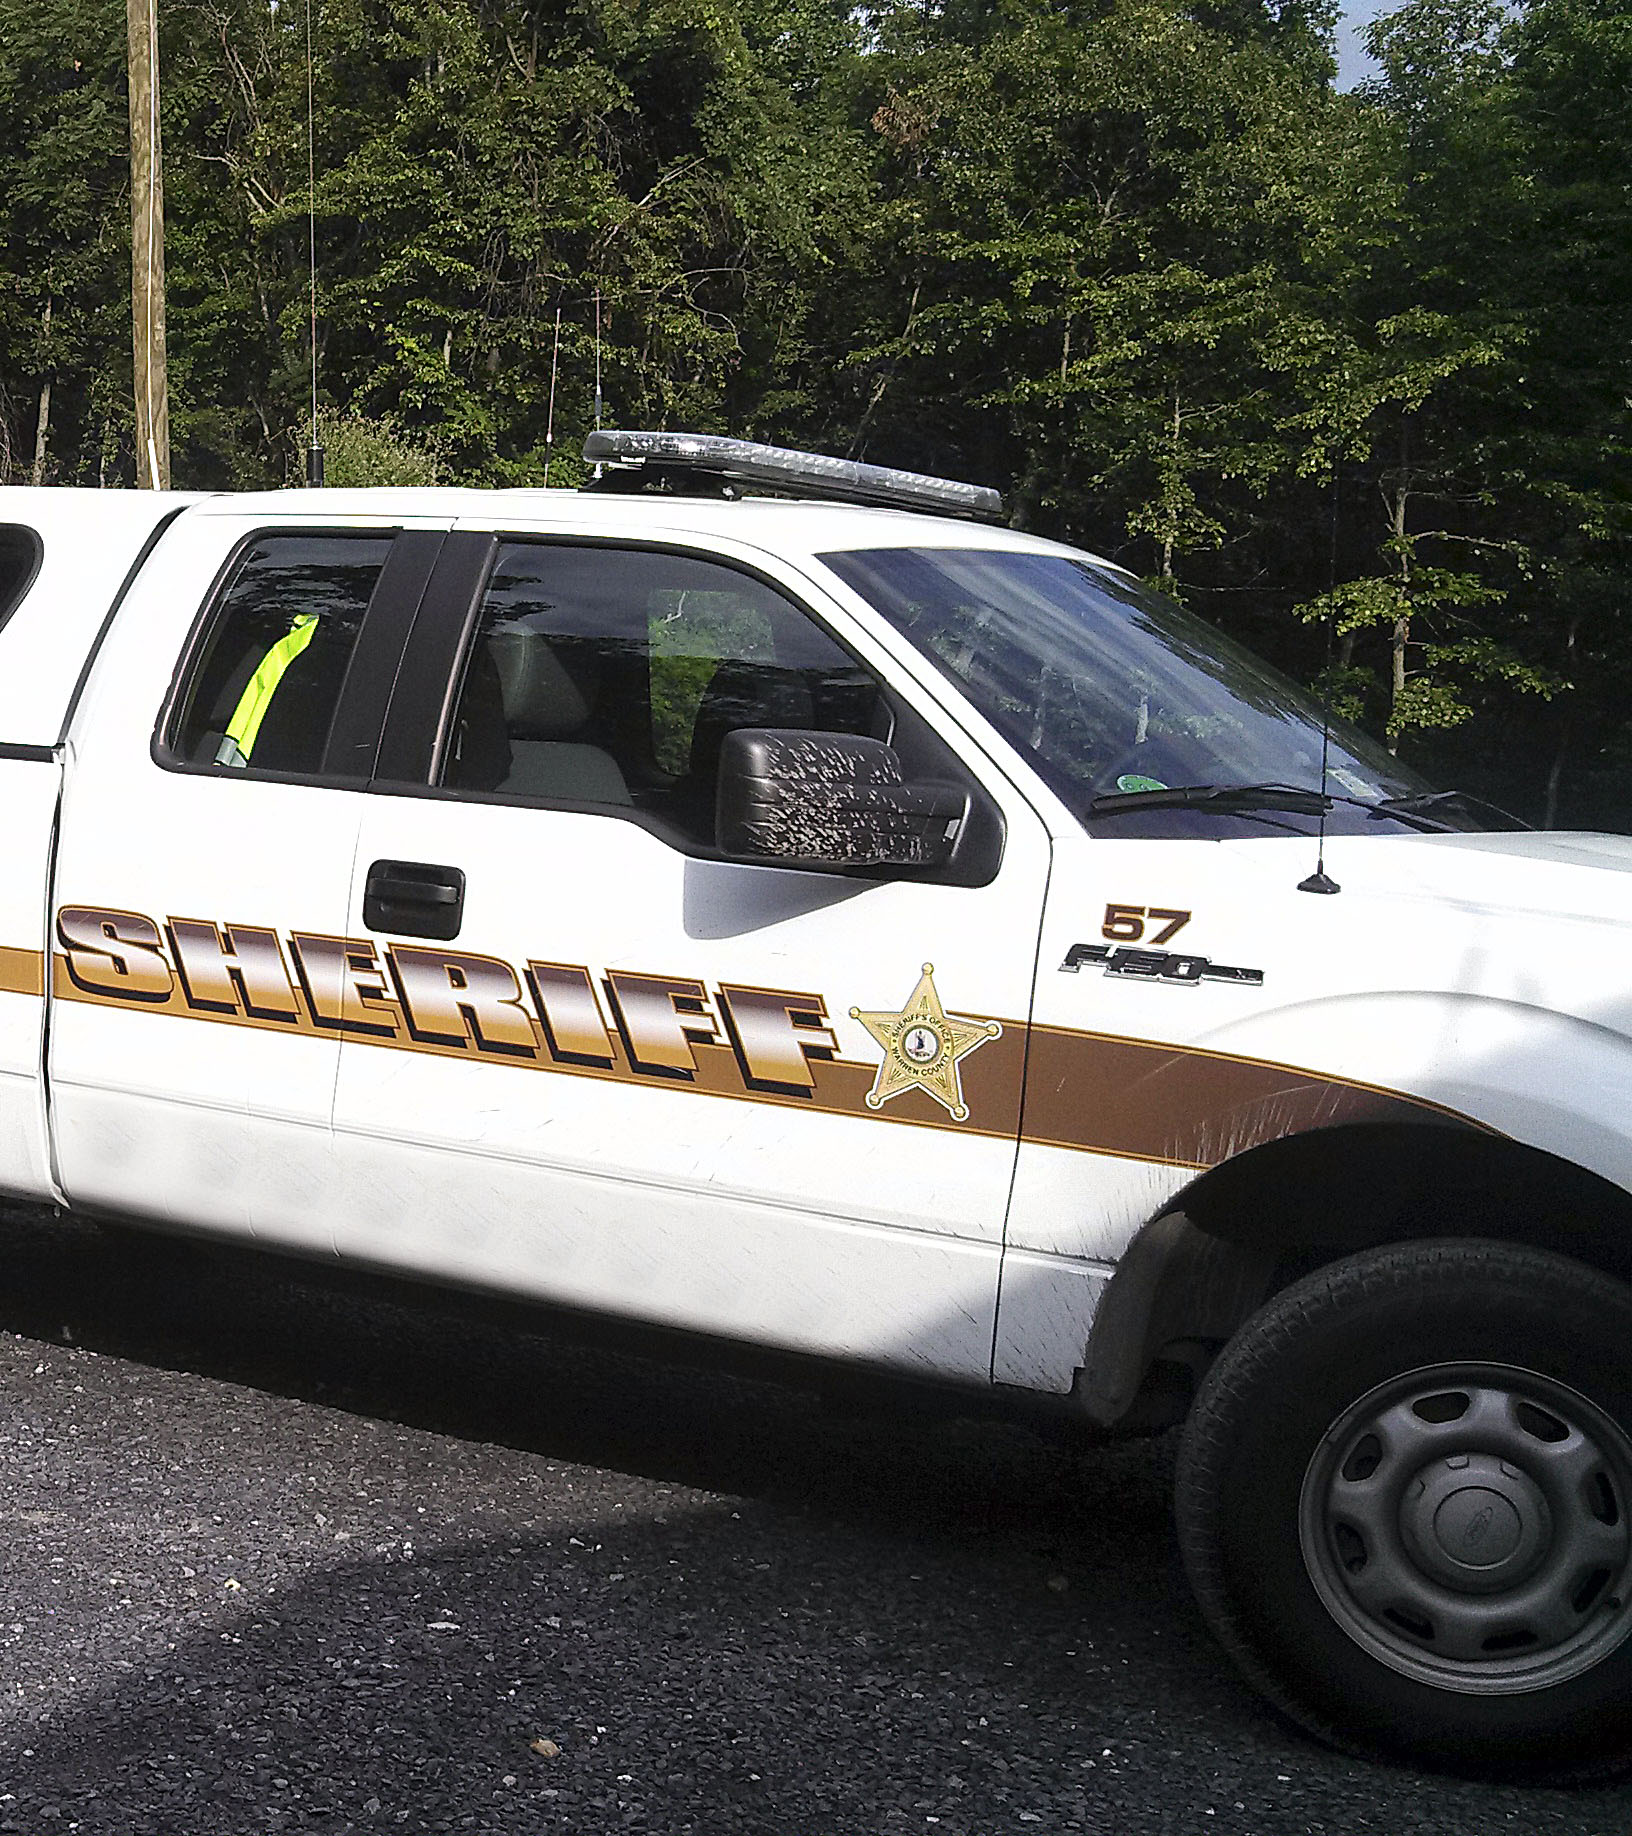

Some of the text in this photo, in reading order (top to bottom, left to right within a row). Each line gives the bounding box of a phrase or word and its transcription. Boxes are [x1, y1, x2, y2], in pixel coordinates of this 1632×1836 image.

[1101, 902, 1192, 945] 57
[56, 904, 840, 1099] SHERIFF
[892, 1014, 950, 1043] SHERIFF'S OFFICE
[892, 1047, 949, 1076] WARREN COUNTY
